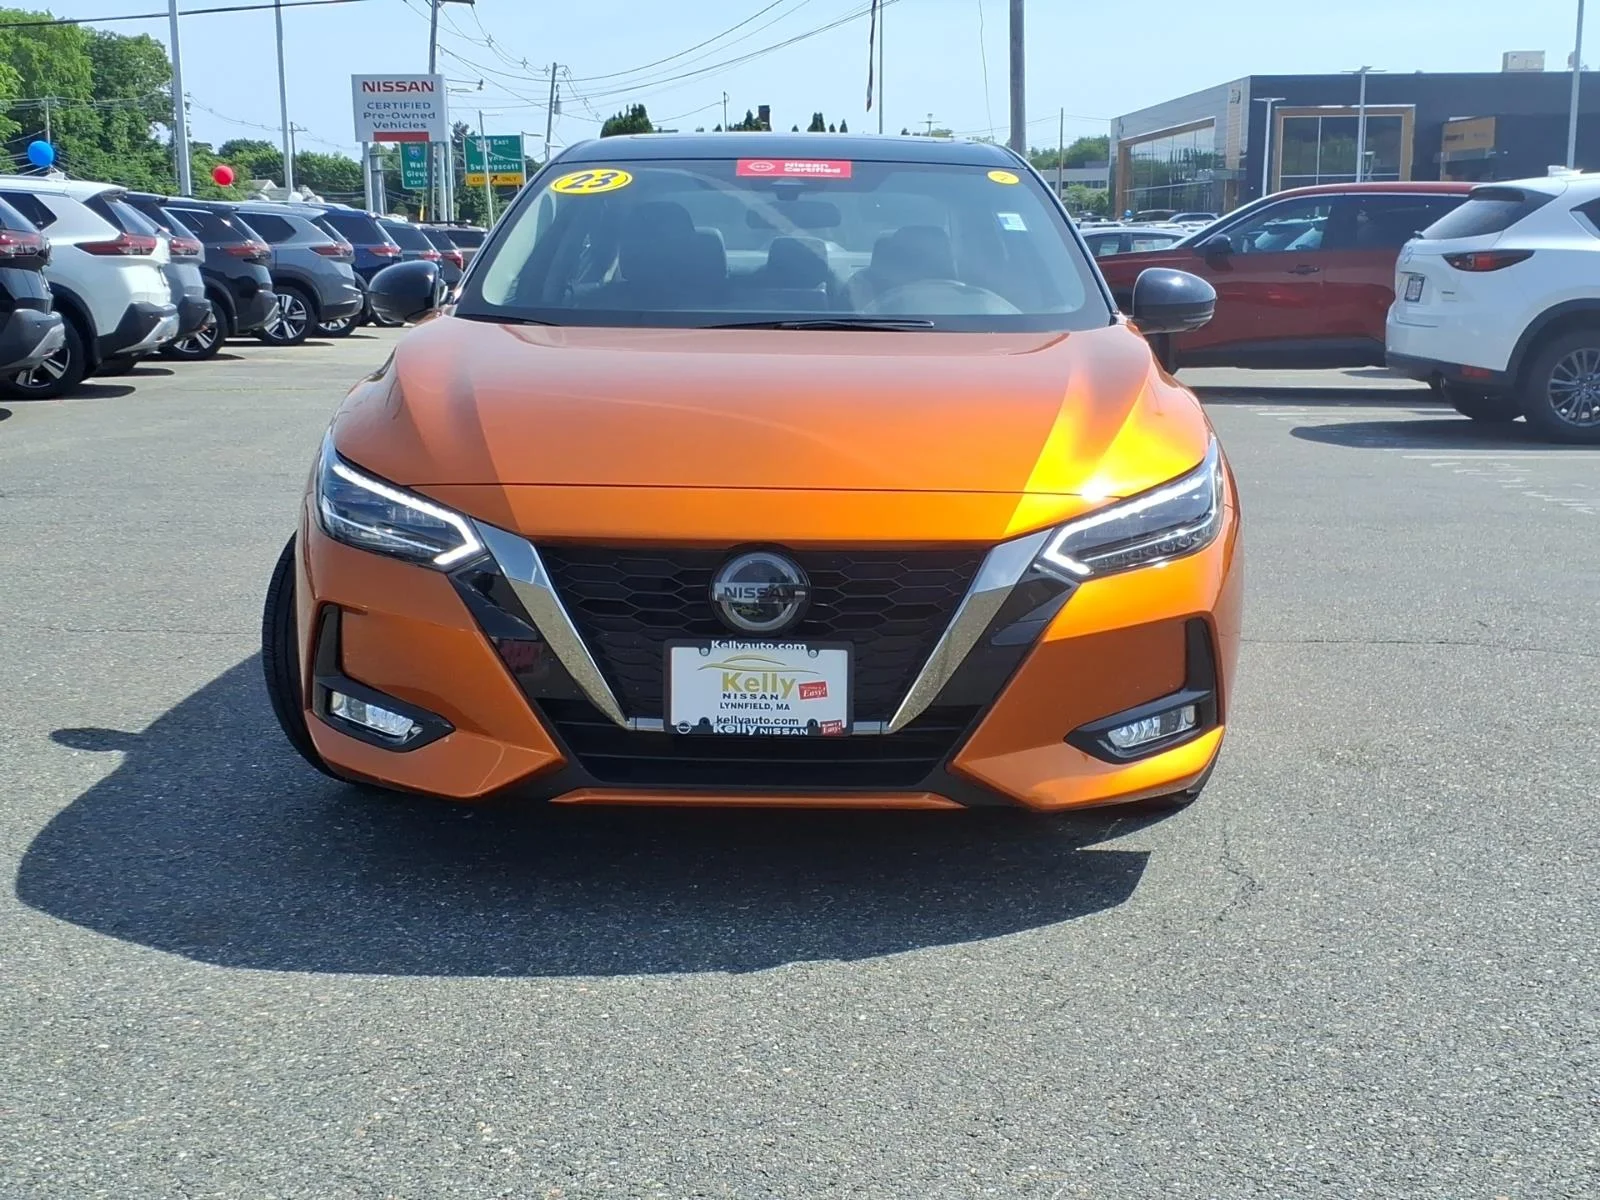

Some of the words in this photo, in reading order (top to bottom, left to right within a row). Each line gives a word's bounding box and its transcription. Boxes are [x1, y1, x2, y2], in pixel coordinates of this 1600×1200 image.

[362, 81, 434, 92] NISSAN
[373, 121, 427, 129] Vehicles
[562, 173, 619, 190] 23
[711, 640, 807, 651] Kellyauto.com
[722, 672, 796, 699] Kelly
[720, 703, 773, 712] LYNNFIELD,
[716, 715, 799, 726] kellyauto.com
[713, 723, 757, 736] Kelly
[759, 728, 808, 736] NISSAN
